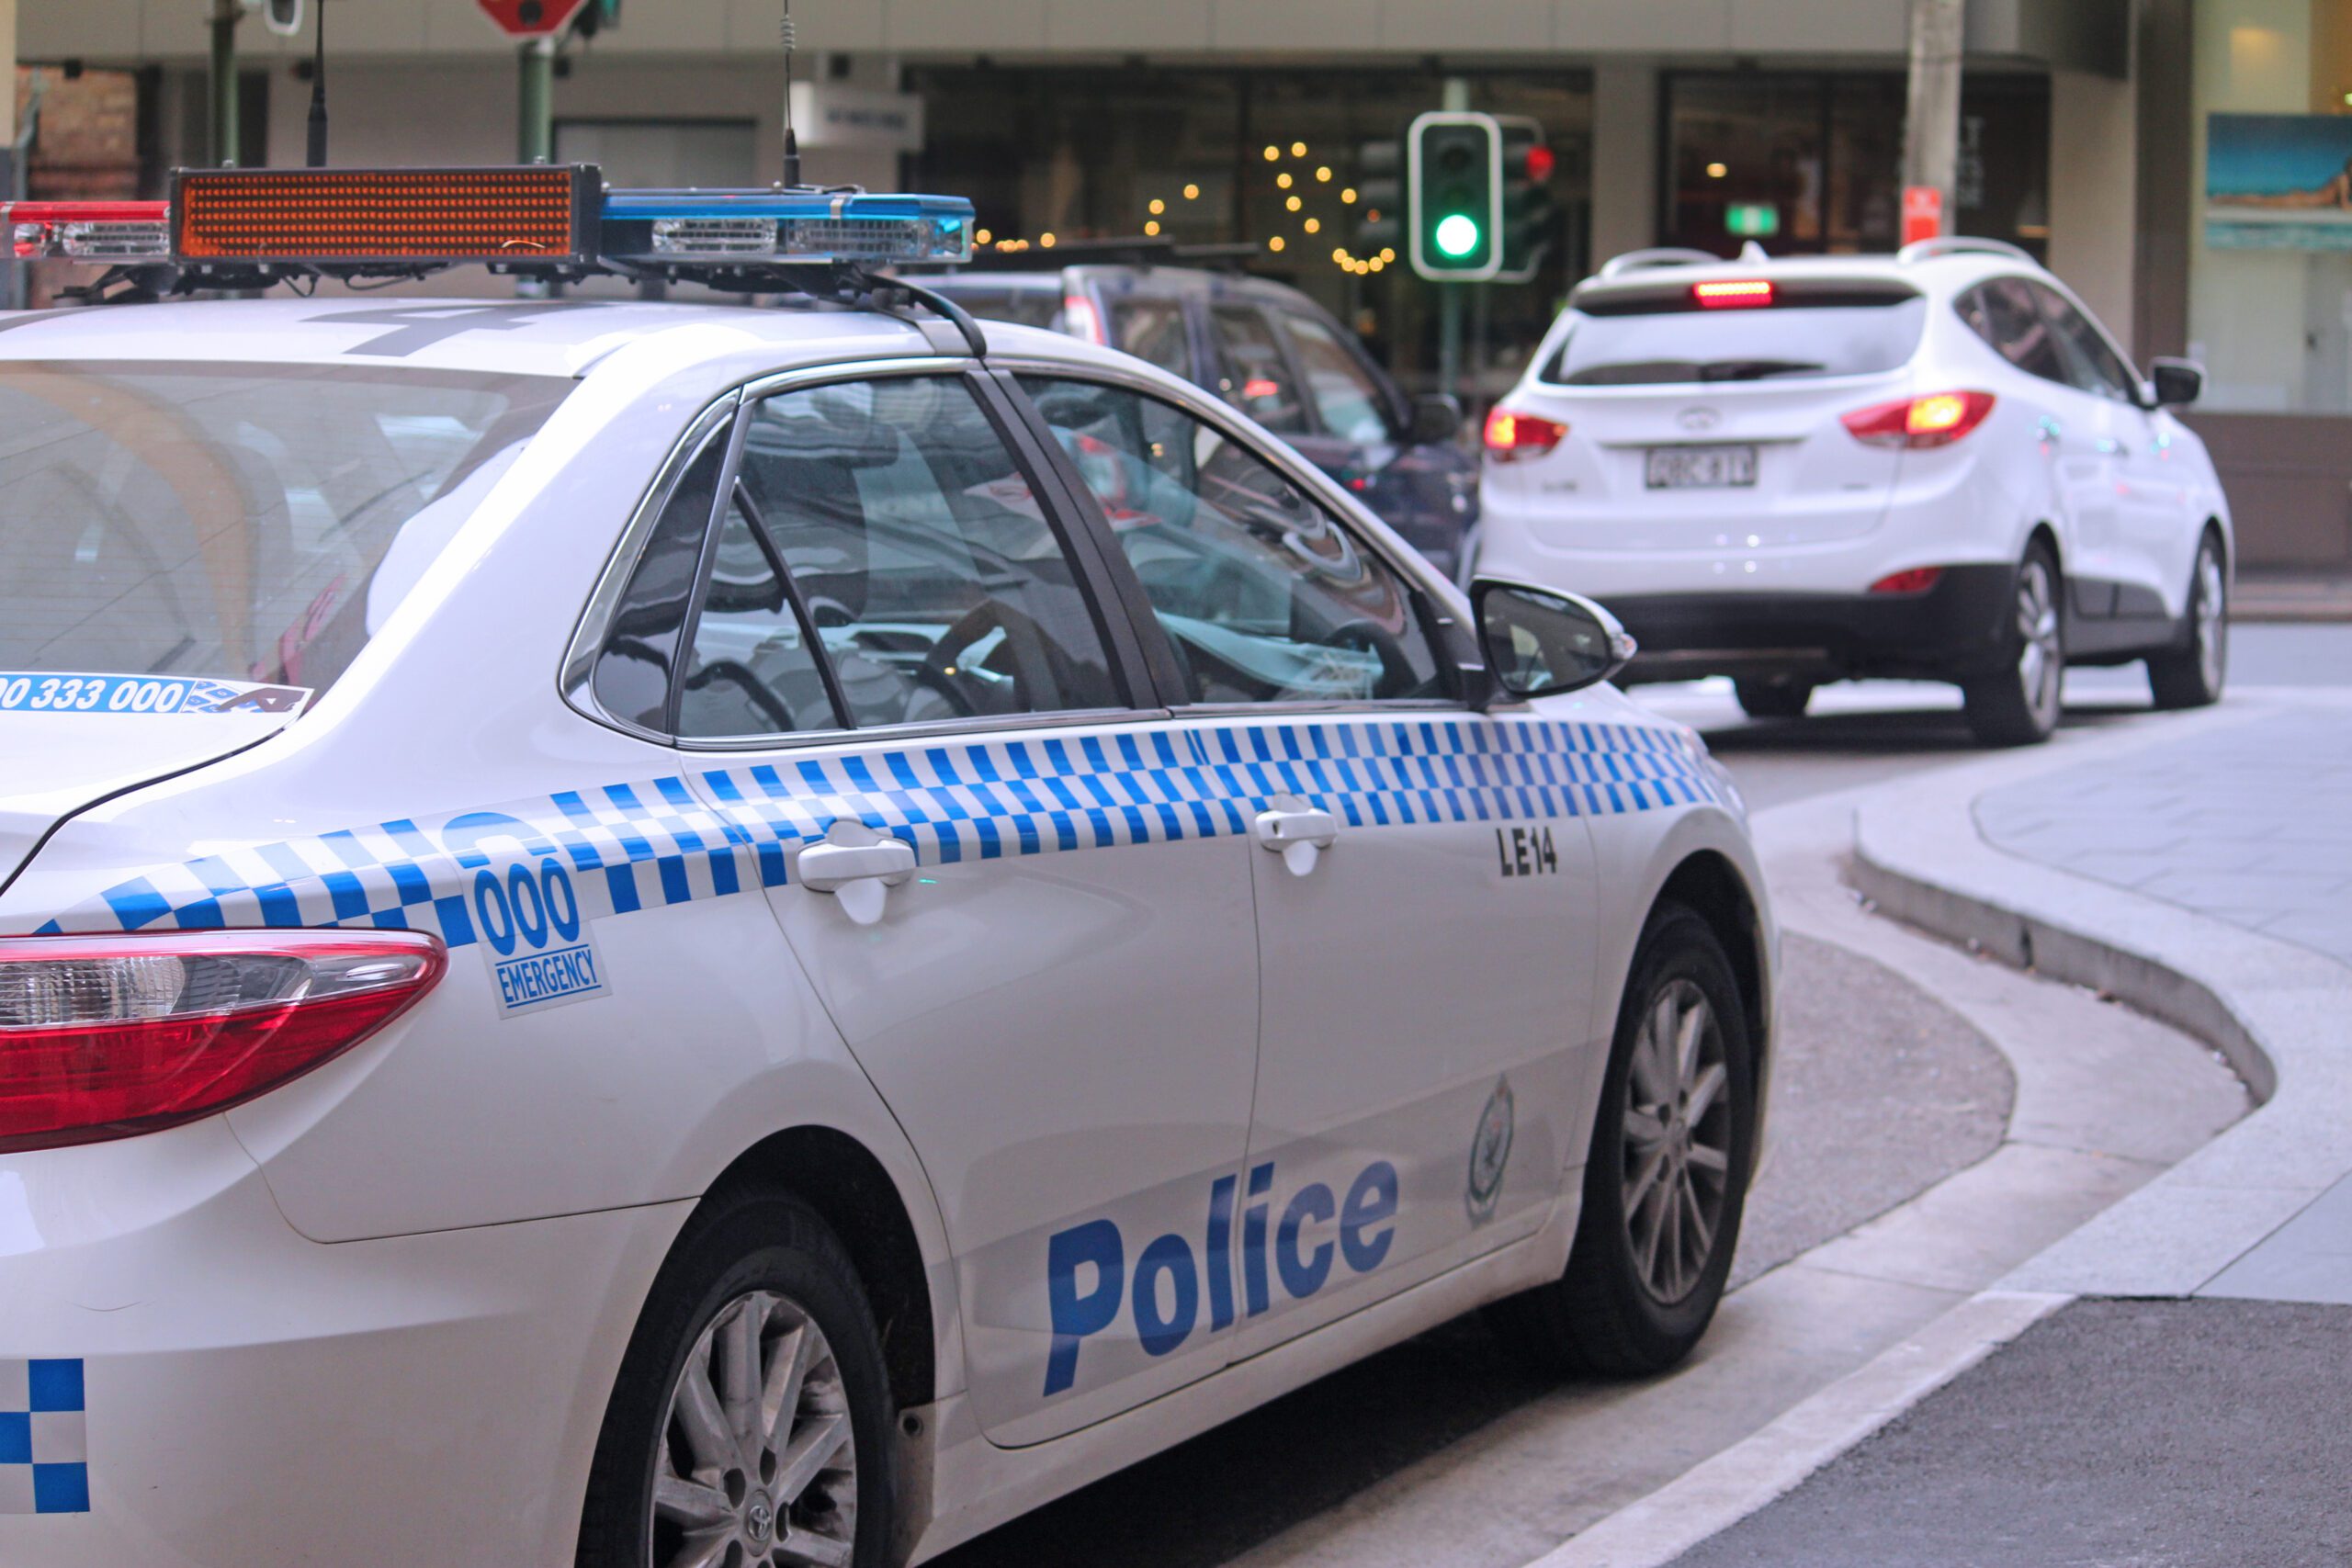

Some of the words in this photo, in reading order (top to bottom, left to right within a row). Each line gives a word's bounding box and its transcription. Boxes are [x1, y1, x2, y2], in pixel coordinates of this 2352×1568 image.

[30, 678, 107, 710] 333
[108, 680, 185, 713] 000
[1496, 827, 1556, 876] LE14
[474, 857, 580, 956] 000
[497, 949, 597, 1003] EMERGENCY
[1043, 1161, 1398, 1396] Police
